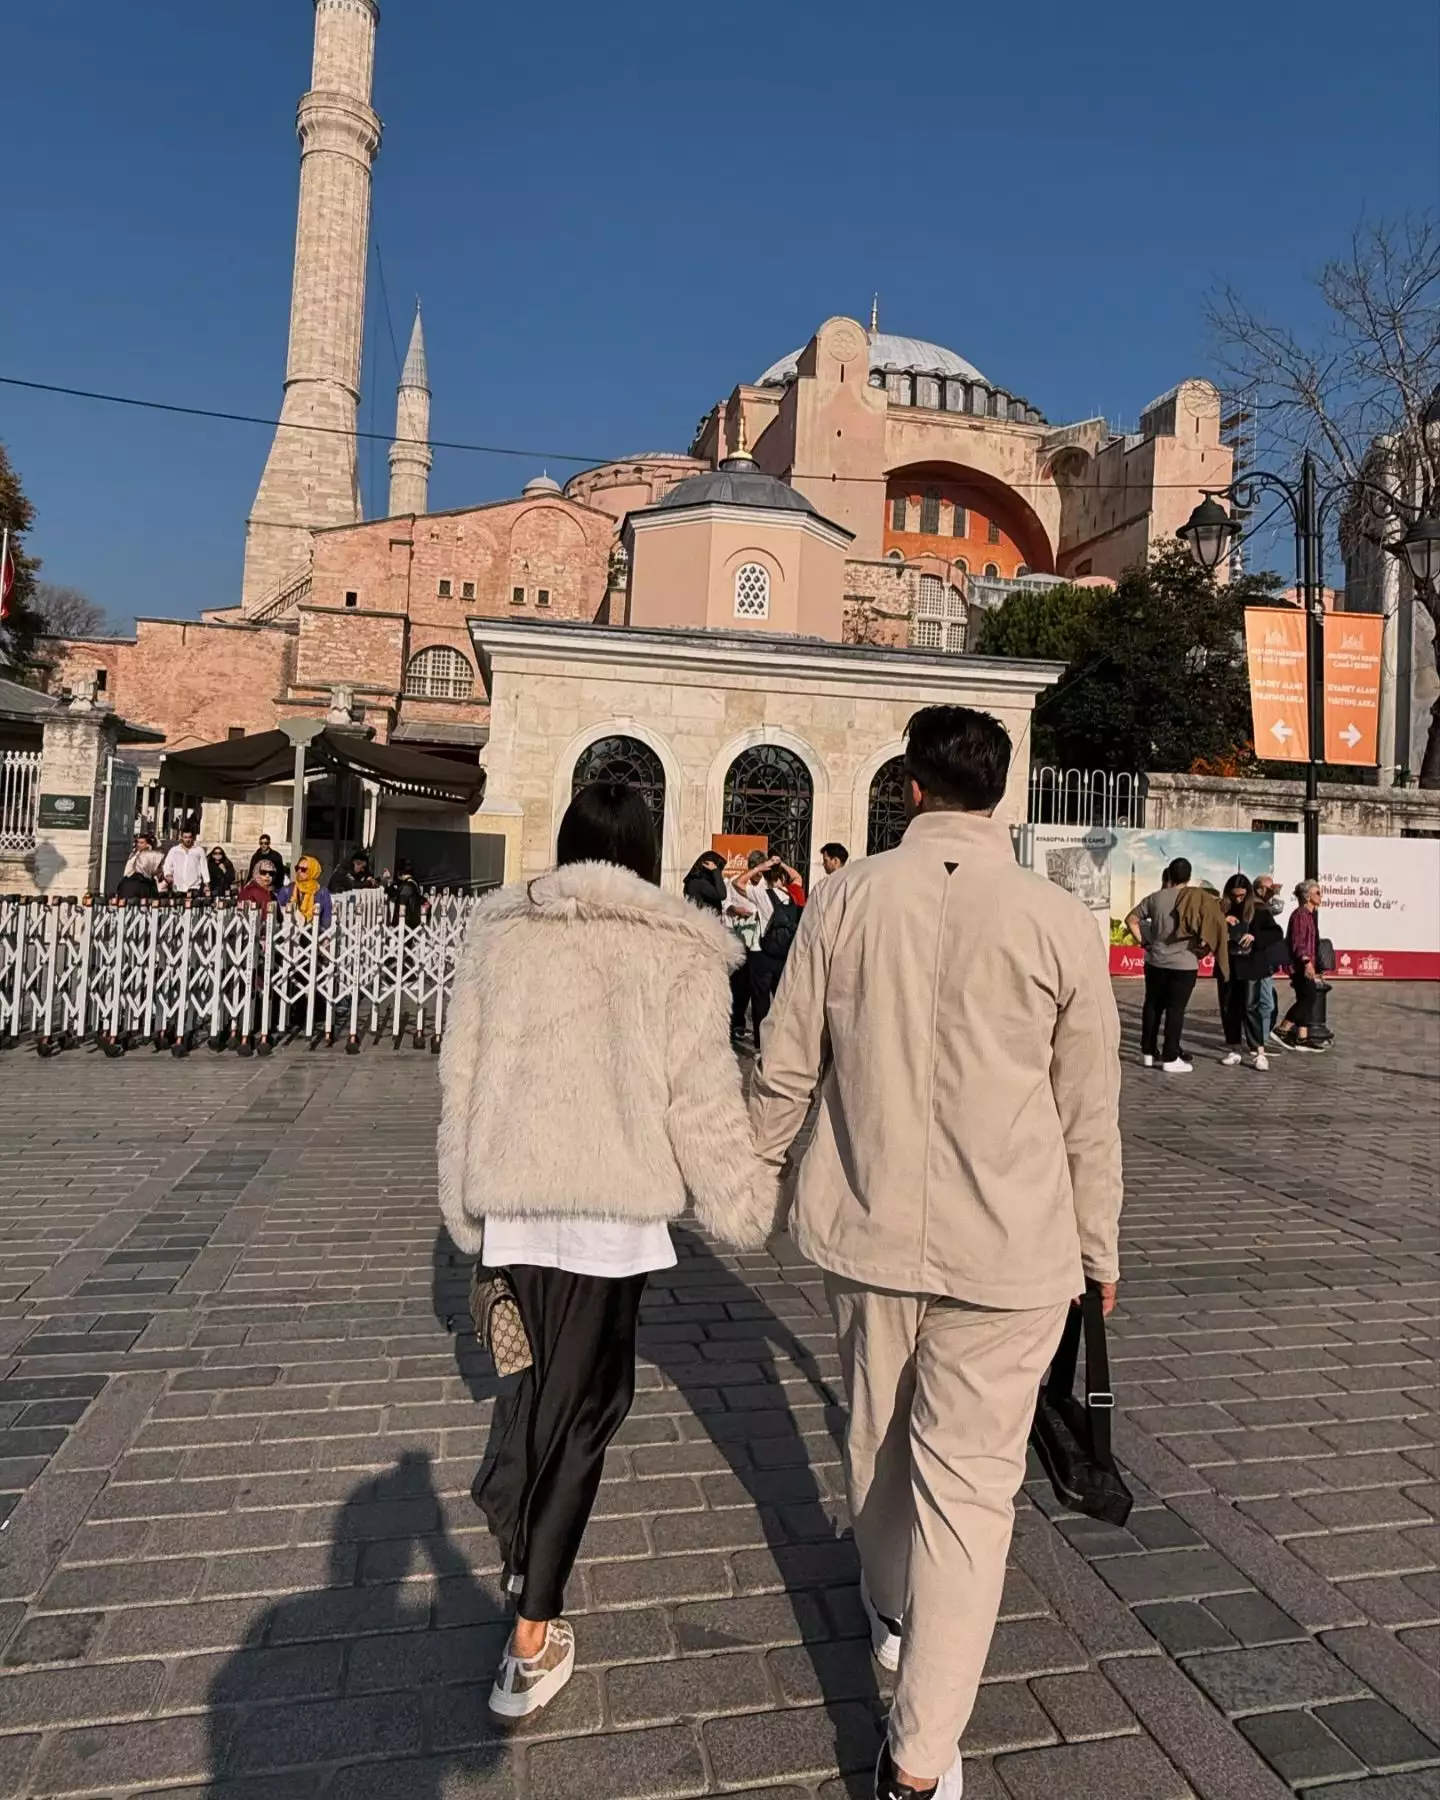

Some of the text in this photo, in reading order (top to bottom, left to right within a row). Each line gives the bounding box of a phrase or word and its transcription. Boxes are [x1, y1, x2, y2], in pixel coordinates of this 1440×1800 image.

[1350, 873, 1360, 883] bu
[1321, 885, 1383, 897] ihimizin Sözü;
[1321, 898, 1370, 909] niyetimizin
[1120, 954, 1145, 970] Ayas
